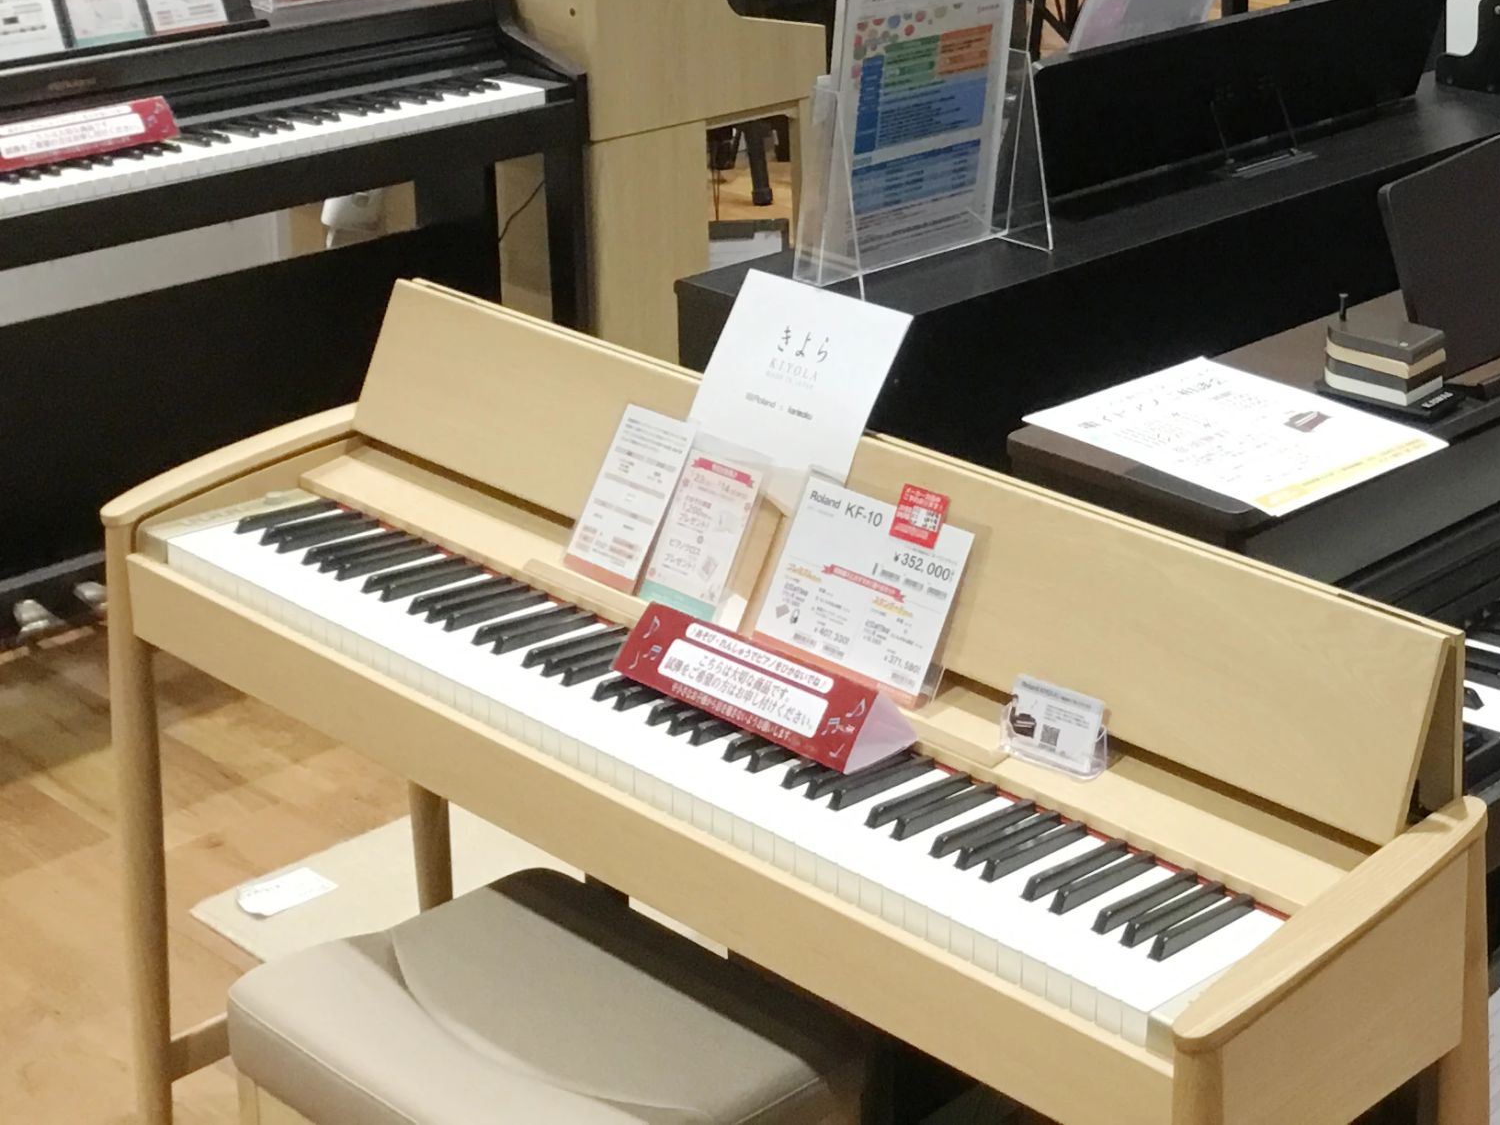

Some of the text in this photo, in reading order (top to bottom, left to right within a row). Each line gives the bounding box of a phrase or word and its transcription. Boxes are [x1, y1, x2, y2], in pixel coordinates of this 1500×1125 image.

[778, 326, 829, 363] きよら
[769, 357, 818, 381] KIYOLA
[810, 490, 883, 527] Roland KF-10
[663, 655, 814, 732] 試弾をご希望の方はお申し付けください。
[699, 654, 791, 702] こちらは大切な商品です。
